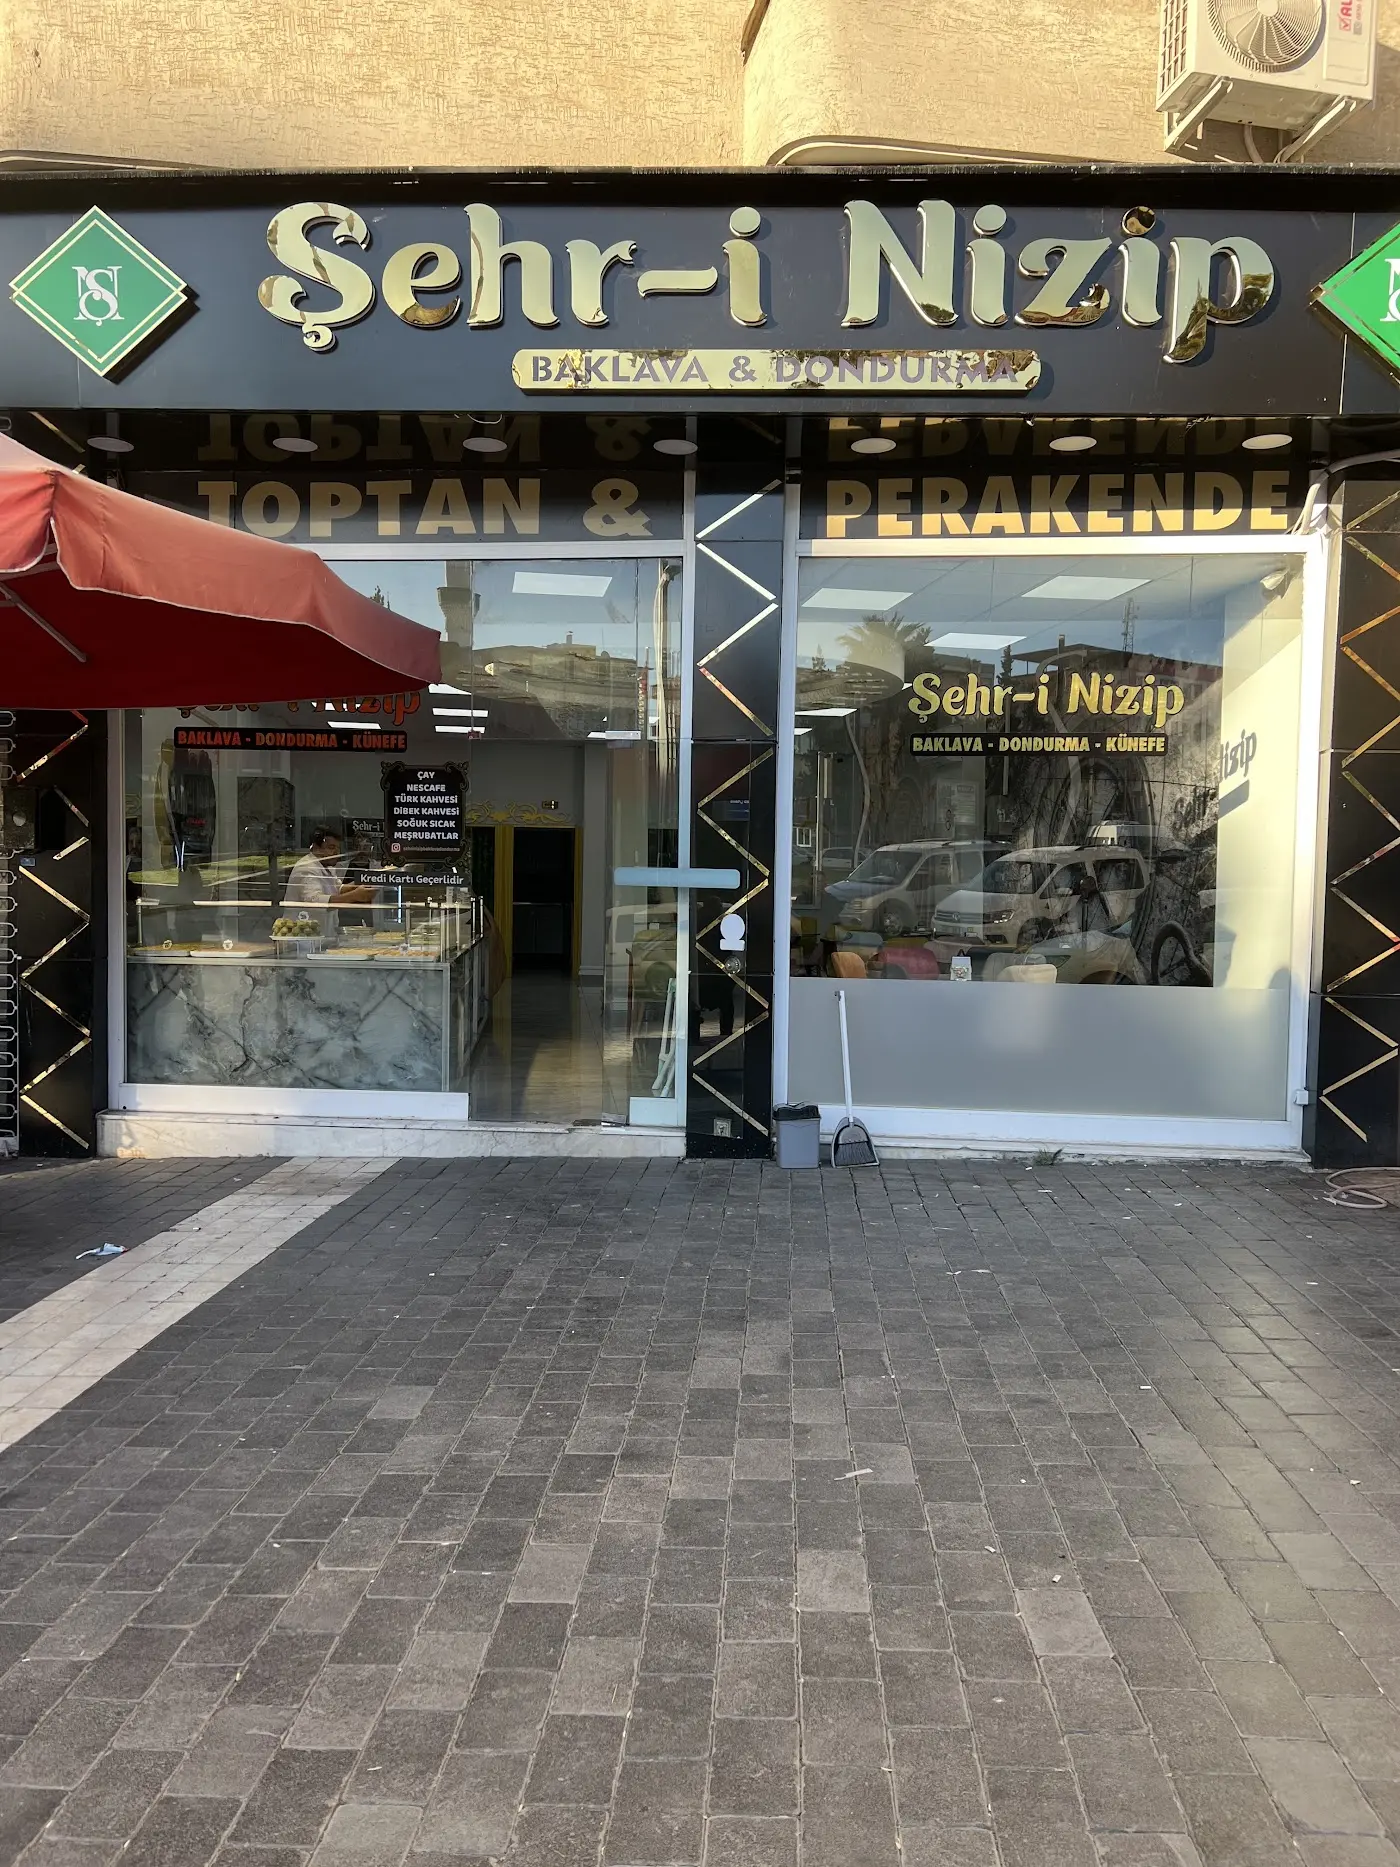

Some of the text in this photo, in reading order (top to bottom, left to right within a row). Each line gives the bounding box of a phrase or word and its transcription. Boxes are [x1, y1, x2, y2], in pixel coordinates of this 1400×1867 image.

[258, 202, 767, 352] Şehr-i
[841, 200, 1275, 364] Nizip
[532, 355, 1019, 384] BAKLAVA & DONDURMA
[197, 477, 653, 538] TOPTAN &
[825, 470, 1290, 538] PERAKENDE
[907, 672, 1185, 728] Şehr-i Nizip
[177, 730, 242, 746] BAKLAVA
[255, 732, 338, 748] DONDURMA
[352, 731, 406, 749] KÜNEFE
[913, 737, 984, 752] BAKLAVA
[999, 737, 1090, 752] DONDURMA
[1106, 733, 1165, 752] KÜNEFE
[417, 771, 435, 780] ÇAY
[406, 784, 446, 792] NESCAFE
[395, 793, 419, 803] TÜRK
[396, 818, 428, 828] SOĞUK
[430, 820, 456, 828] SICAK
[394, 832, 459, 841] MEŞRUBATLAR
[360, 873, 464, 885] Kredi Kartı Geçerlidir
